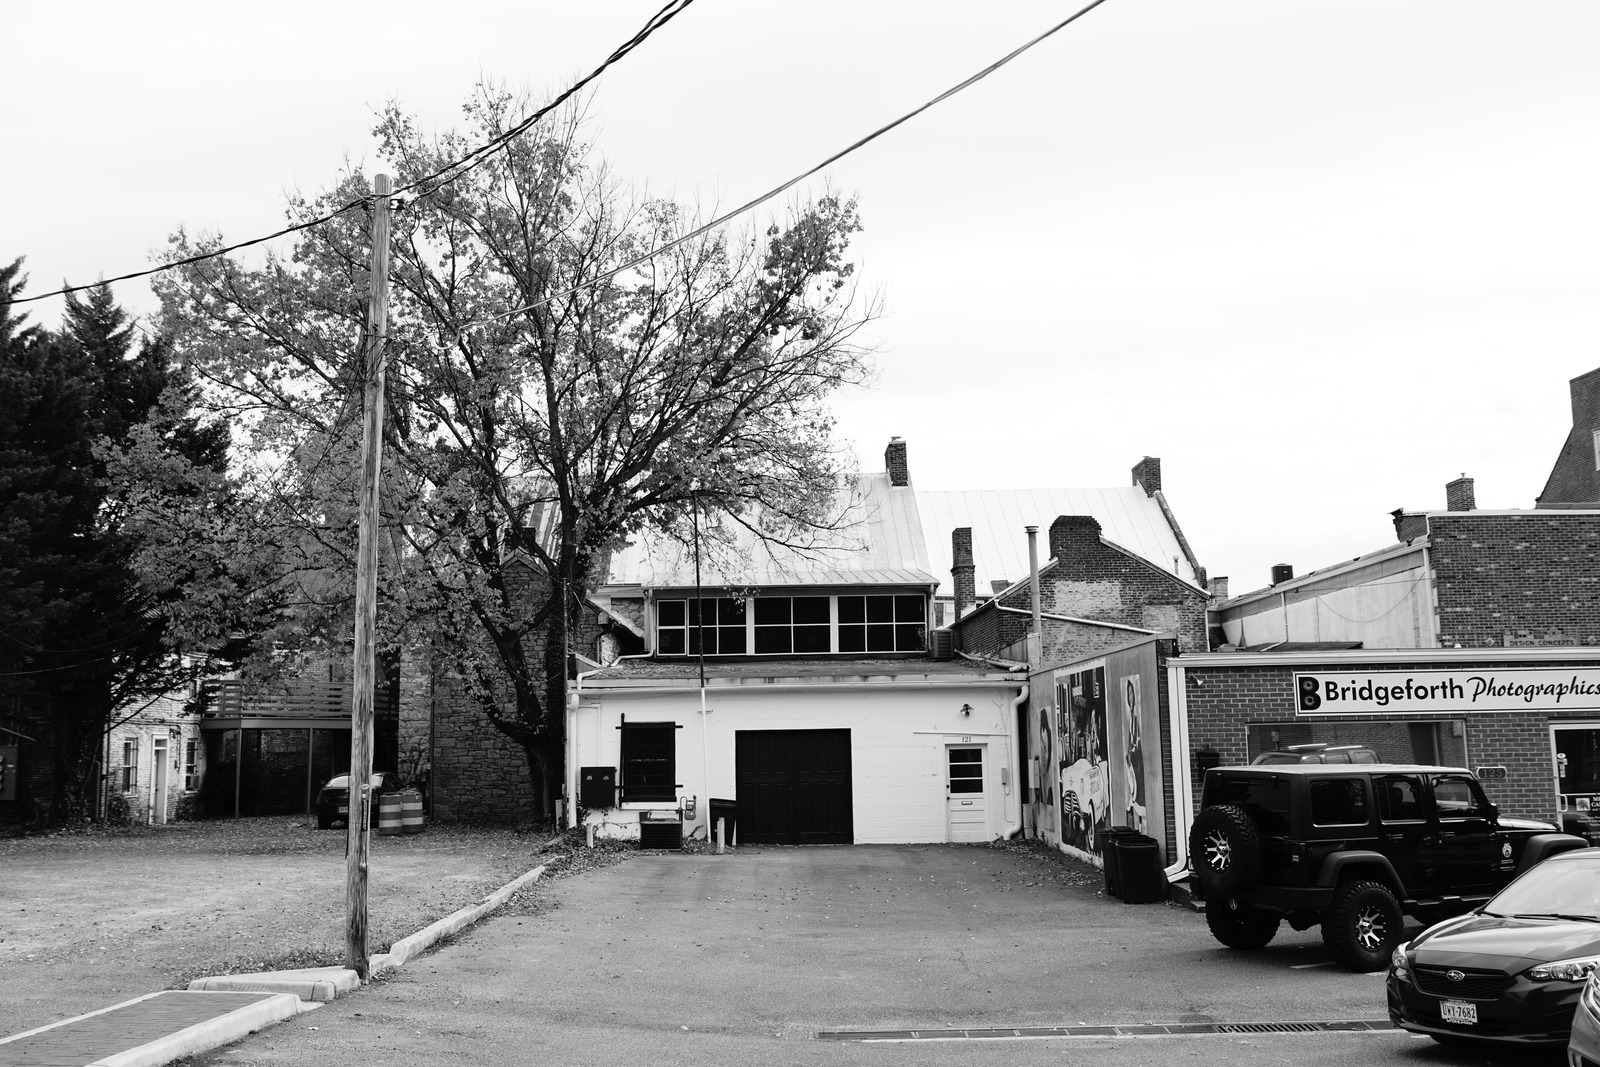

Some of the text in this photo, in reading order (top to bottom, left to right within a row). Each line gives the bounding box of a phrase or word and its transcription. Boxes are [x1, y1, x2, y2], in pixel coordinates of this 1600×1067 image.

[1325, 678, 1464, 705] Bridgeforth
[1467, 675, 1600, 703] Photographics
[1483, 769, 1503, 778] 125
